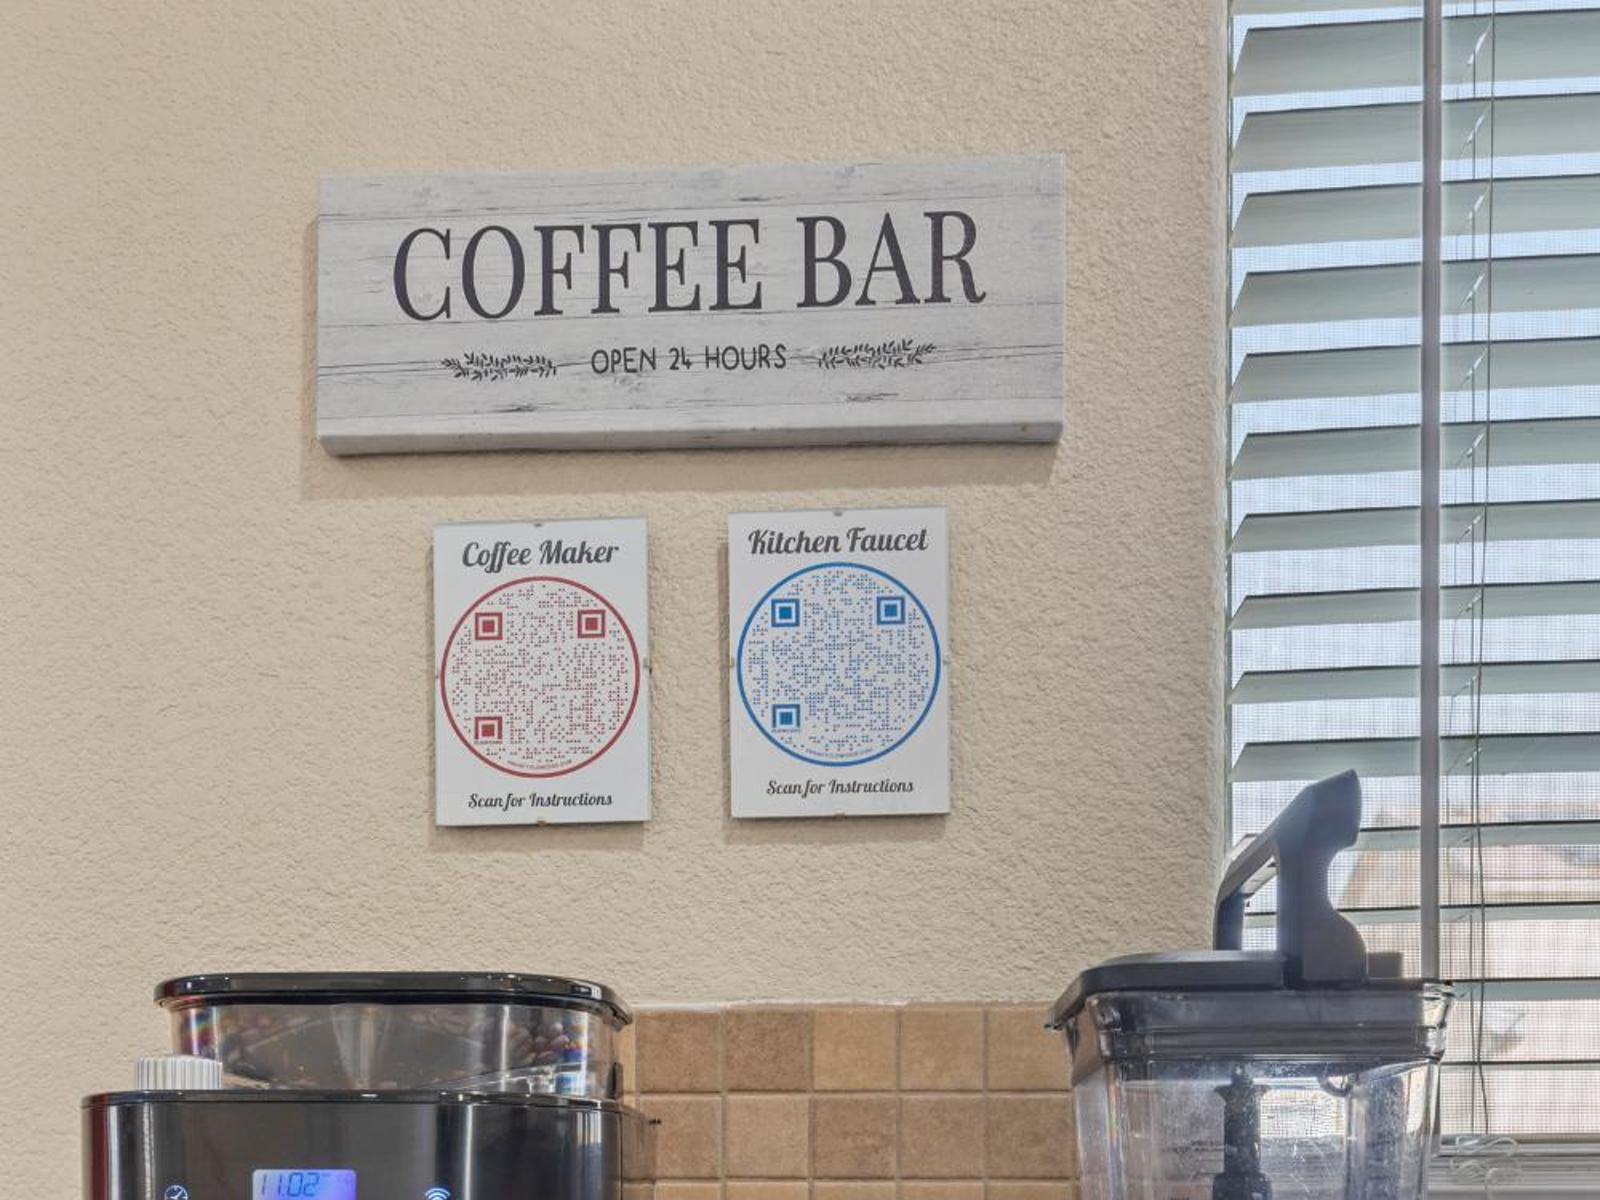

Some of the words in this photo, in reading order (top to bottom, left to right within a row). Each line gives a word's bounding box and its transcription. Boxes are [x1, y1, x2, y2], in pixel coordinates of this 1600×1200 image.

[392, 217, 763, 322] COFFEE
[795, 209, 988, 309] BAR
[591, 346, 657, 375] OPEN
[668, 346, 693, 371] 24
[705, 343, 787, 371] HOURS
[748, 528, 842, 555] Kitchen
[846, 527, 929, 553] Faucet
[462, 540, 532, 574] Coffee
[539, 539, 620, 565] Maker
[468, 793, 502, 808] Scan
[502, 793, 526, 812] for
[528, 792, 613, 808] Instructions
[766, 780, 802, 795] Scan
[801, 779, 826, 799] for
[829, 778, 915, 794] Instructions
